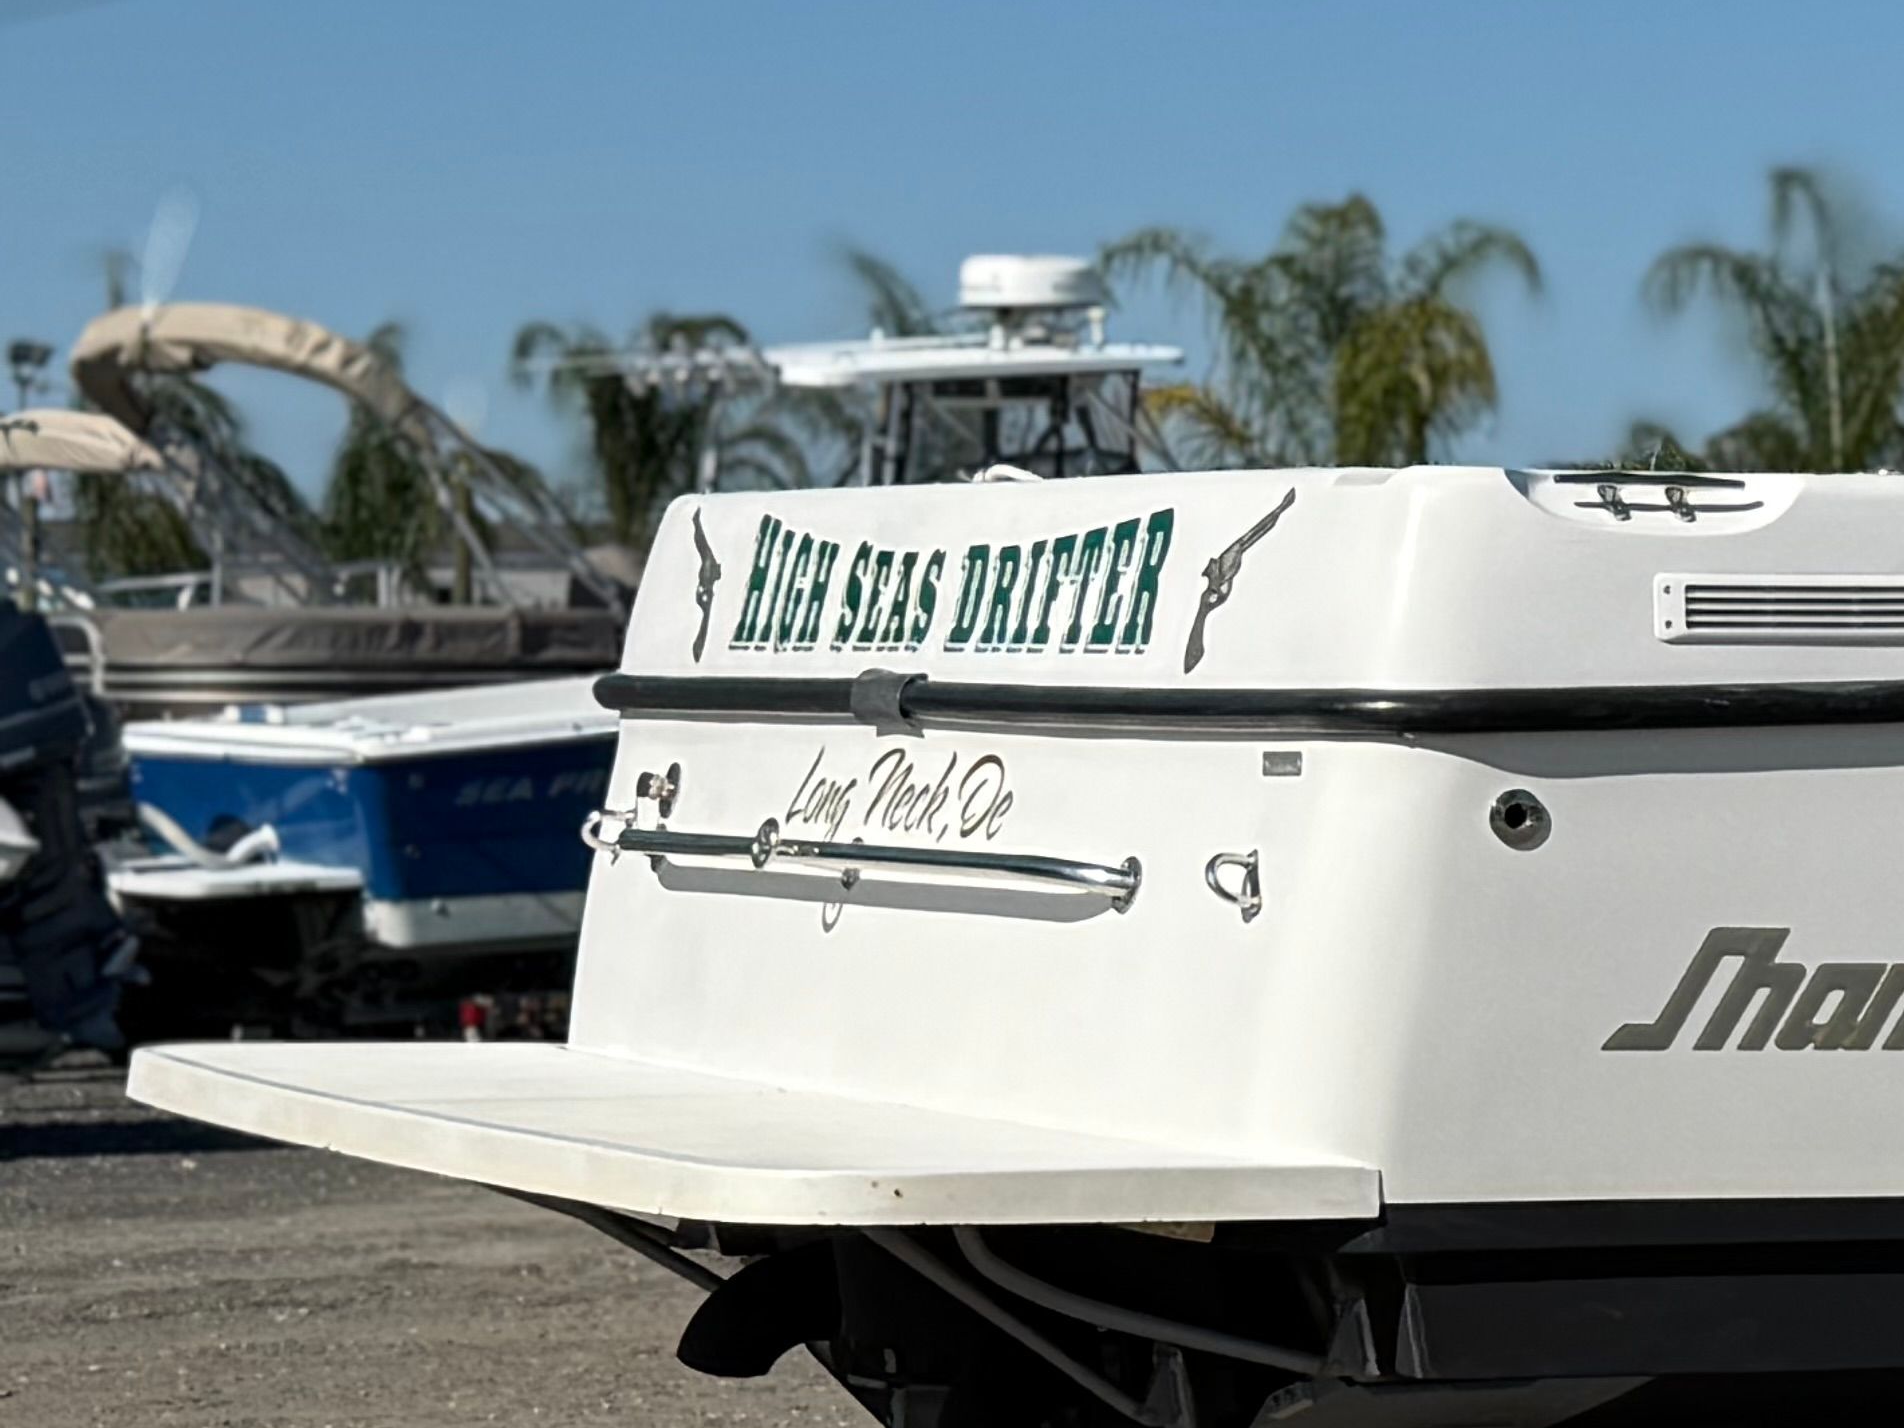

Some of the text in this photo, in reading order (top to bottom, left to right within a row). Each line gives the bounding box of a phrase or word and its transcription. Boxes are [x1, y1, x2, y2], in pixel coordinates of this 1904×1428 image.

[728, 507, 1175, 654] HIGH SEAS DRIFTER
[547, 768, 607, 799] PR
[786, 745, 1013, 844] Long Neck, De
